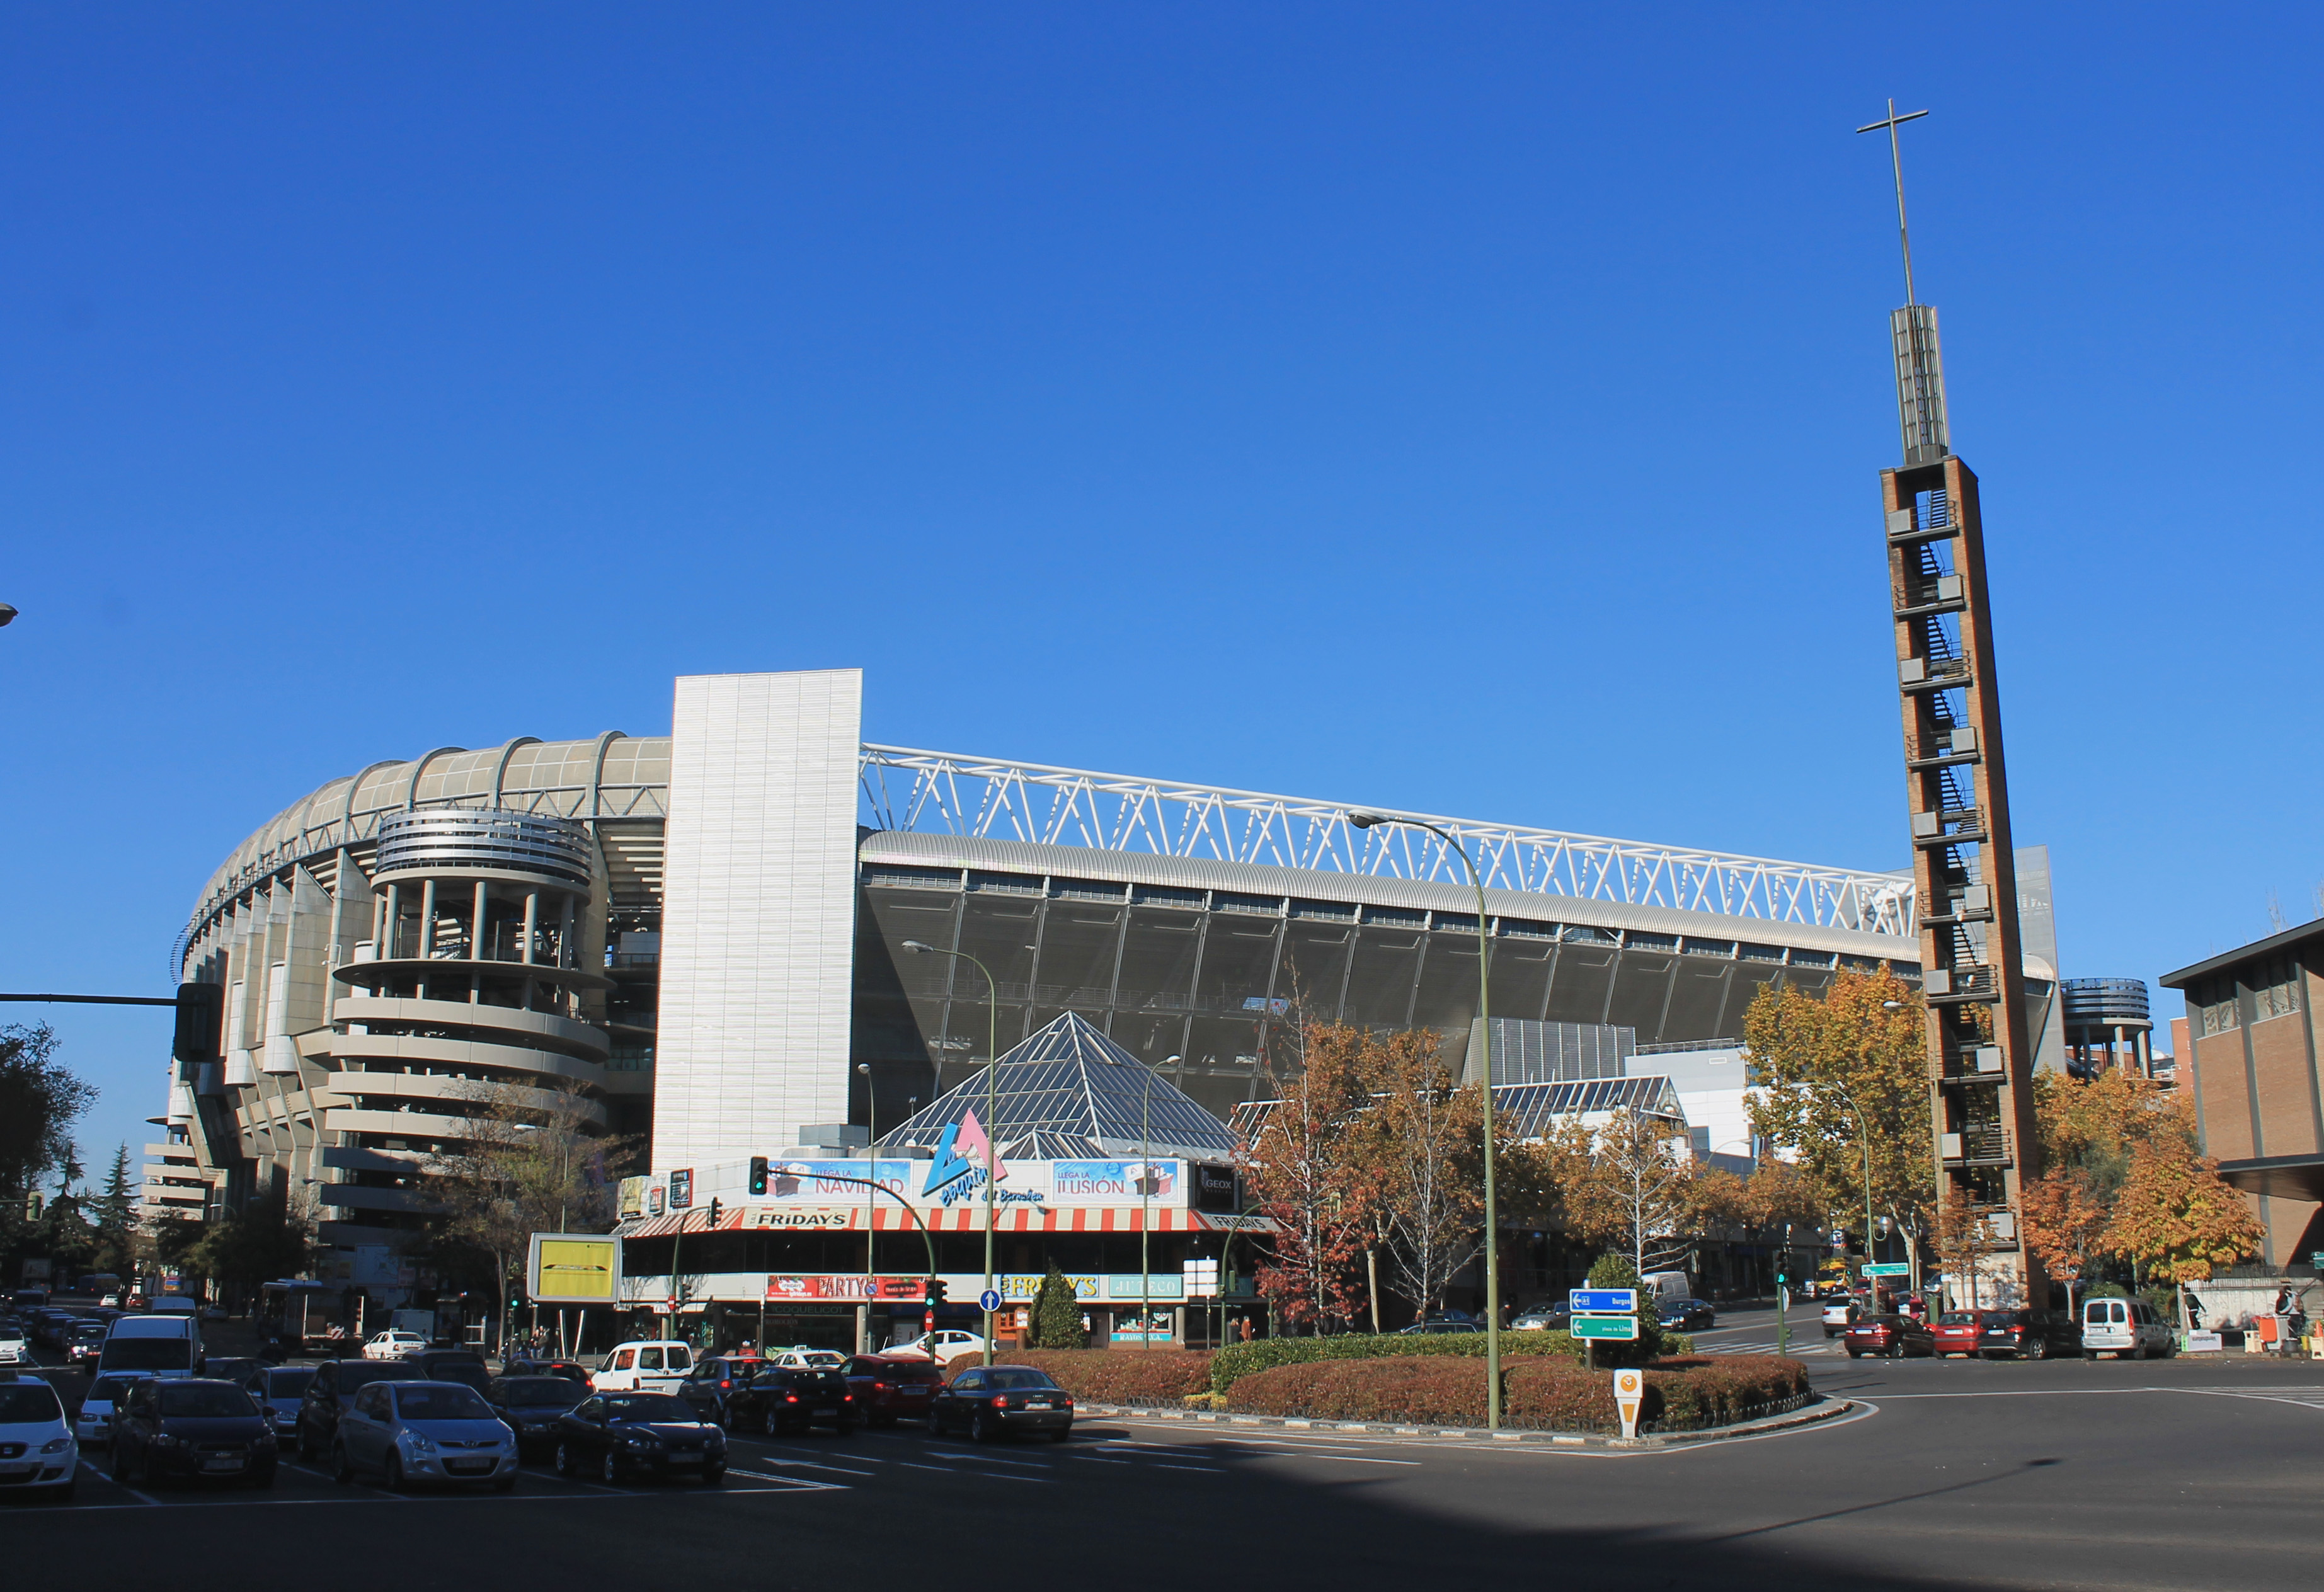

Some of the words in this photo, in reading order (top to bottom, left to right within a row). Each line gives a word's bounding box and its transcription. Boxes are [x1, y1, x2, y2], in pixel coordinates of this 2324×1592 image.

[815, 1178, 905, 1194] NAVIDAD
[1058, 1176, 1125, 1194] ILUSIÓN
[1206, 1179, 1232, 1189] GEOX
[1612, 1297, 1630, 1306] Burgos
[775, 1305, 844, 1314] COQUELICOT
